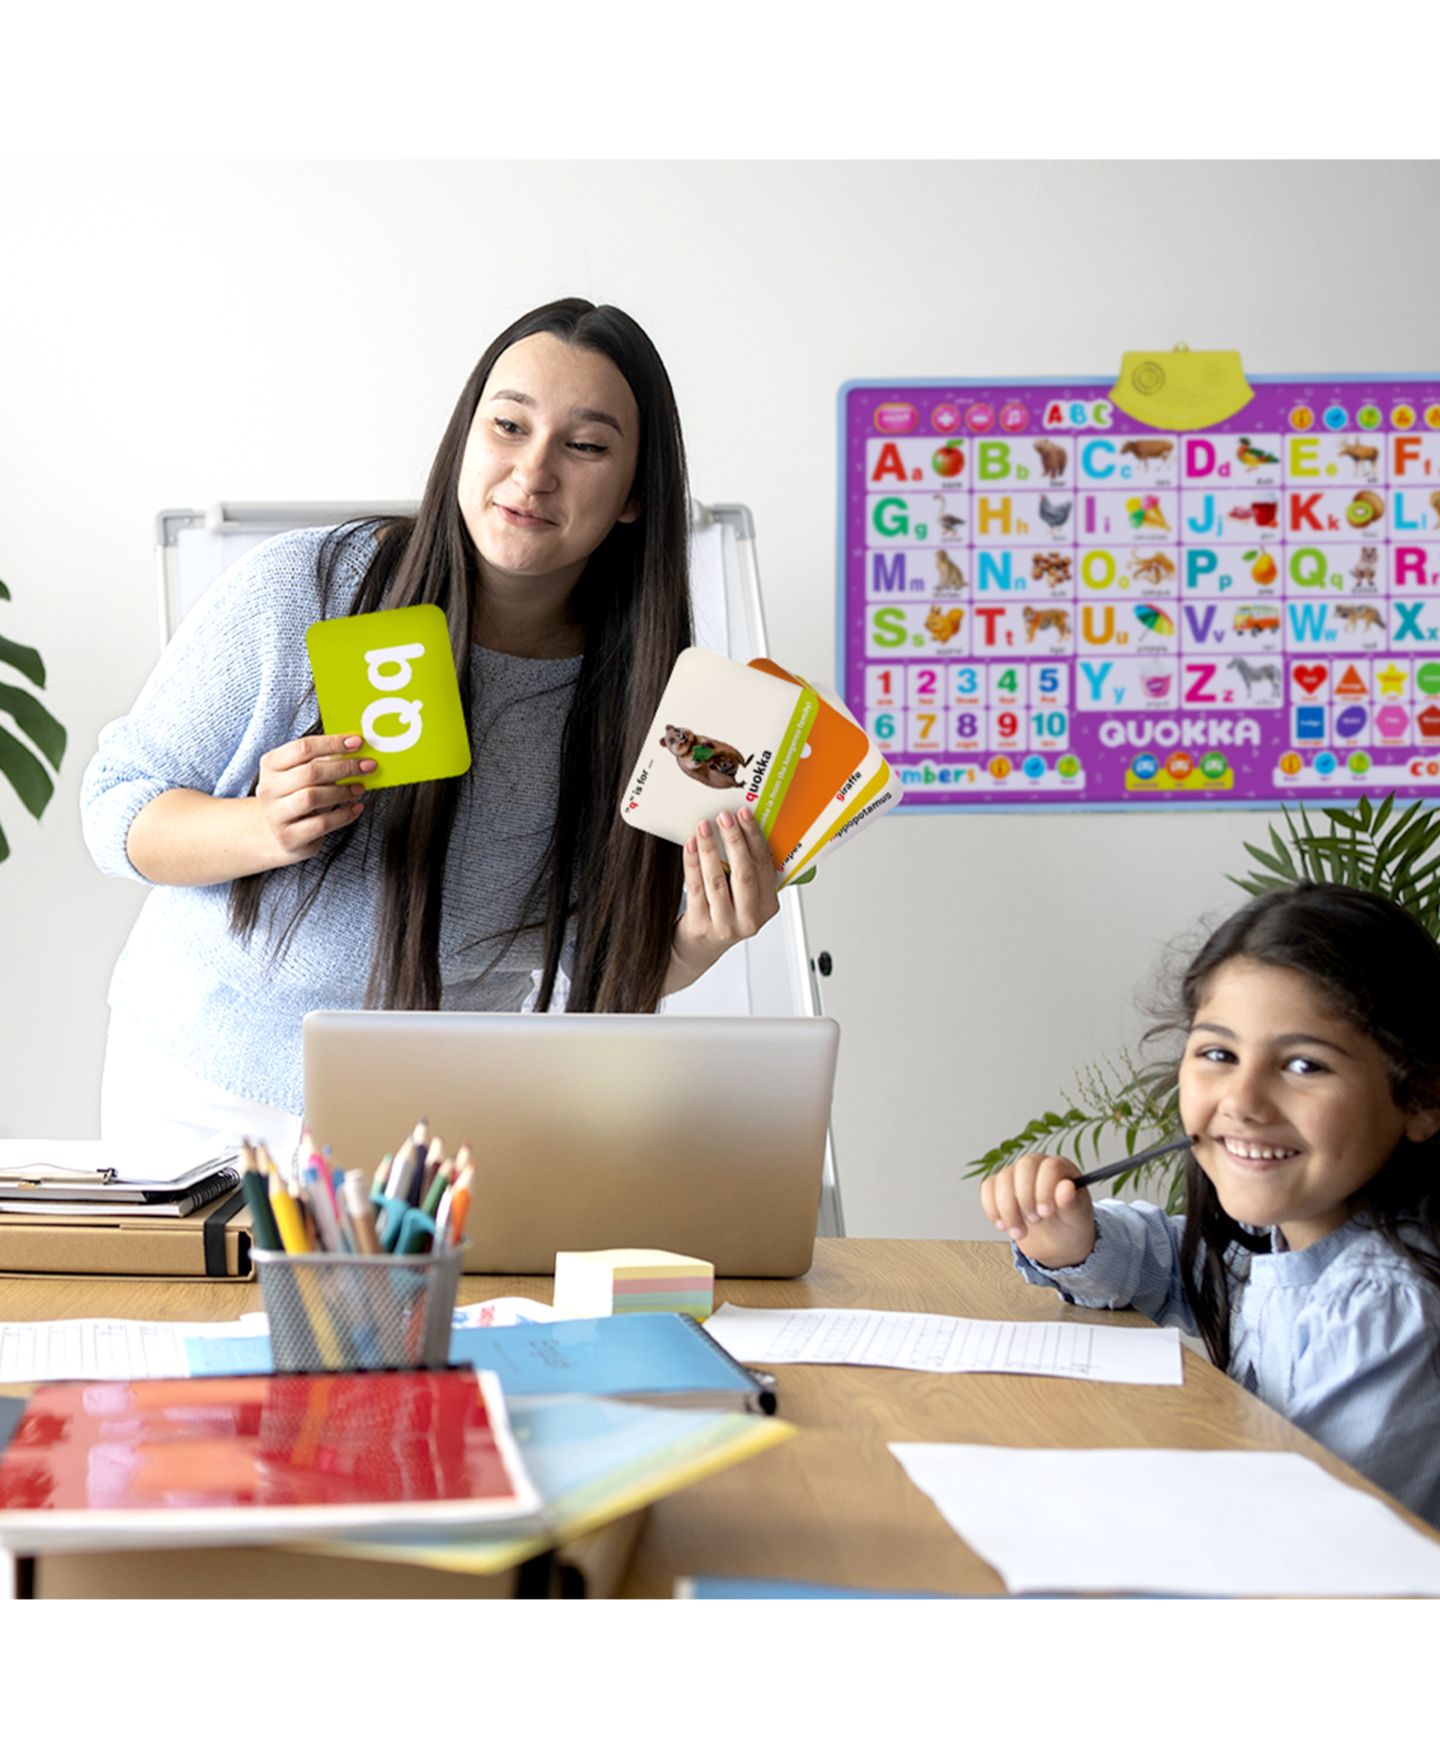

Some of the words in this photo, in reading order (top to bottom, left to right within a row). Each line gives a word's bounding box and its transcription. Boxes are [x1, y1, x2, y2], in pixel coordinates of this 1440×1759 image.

[1047, 403, 1109, 425] ABC
[878, 671, 891, 694] 1
[917, 670, 937, 694] 2
[957, 668, 977, 693] 3
[997, 669, 1018, 693] 4
[1039, 668, 1059, 692] 5
[361, 643, 425, 753] Qq
[875, 714, 895, 739] 6
[917, 714, 936, 739] 7
[957, 713, 977, 738] 8
[997, 712, 1018, 738] 9
[1032, 712, 1066, 737] 10
[1098, 718, 1262, 749] QUOKKA
[637, 769, 650, 785] for
[745, 750, 773, 803] quokka
[836, 771, 862, 802] giraffe
[895, 764, 975, 785] mbers
[633, 786, 643, 796] is
[831, 792, 892, 842] ppopotamus
